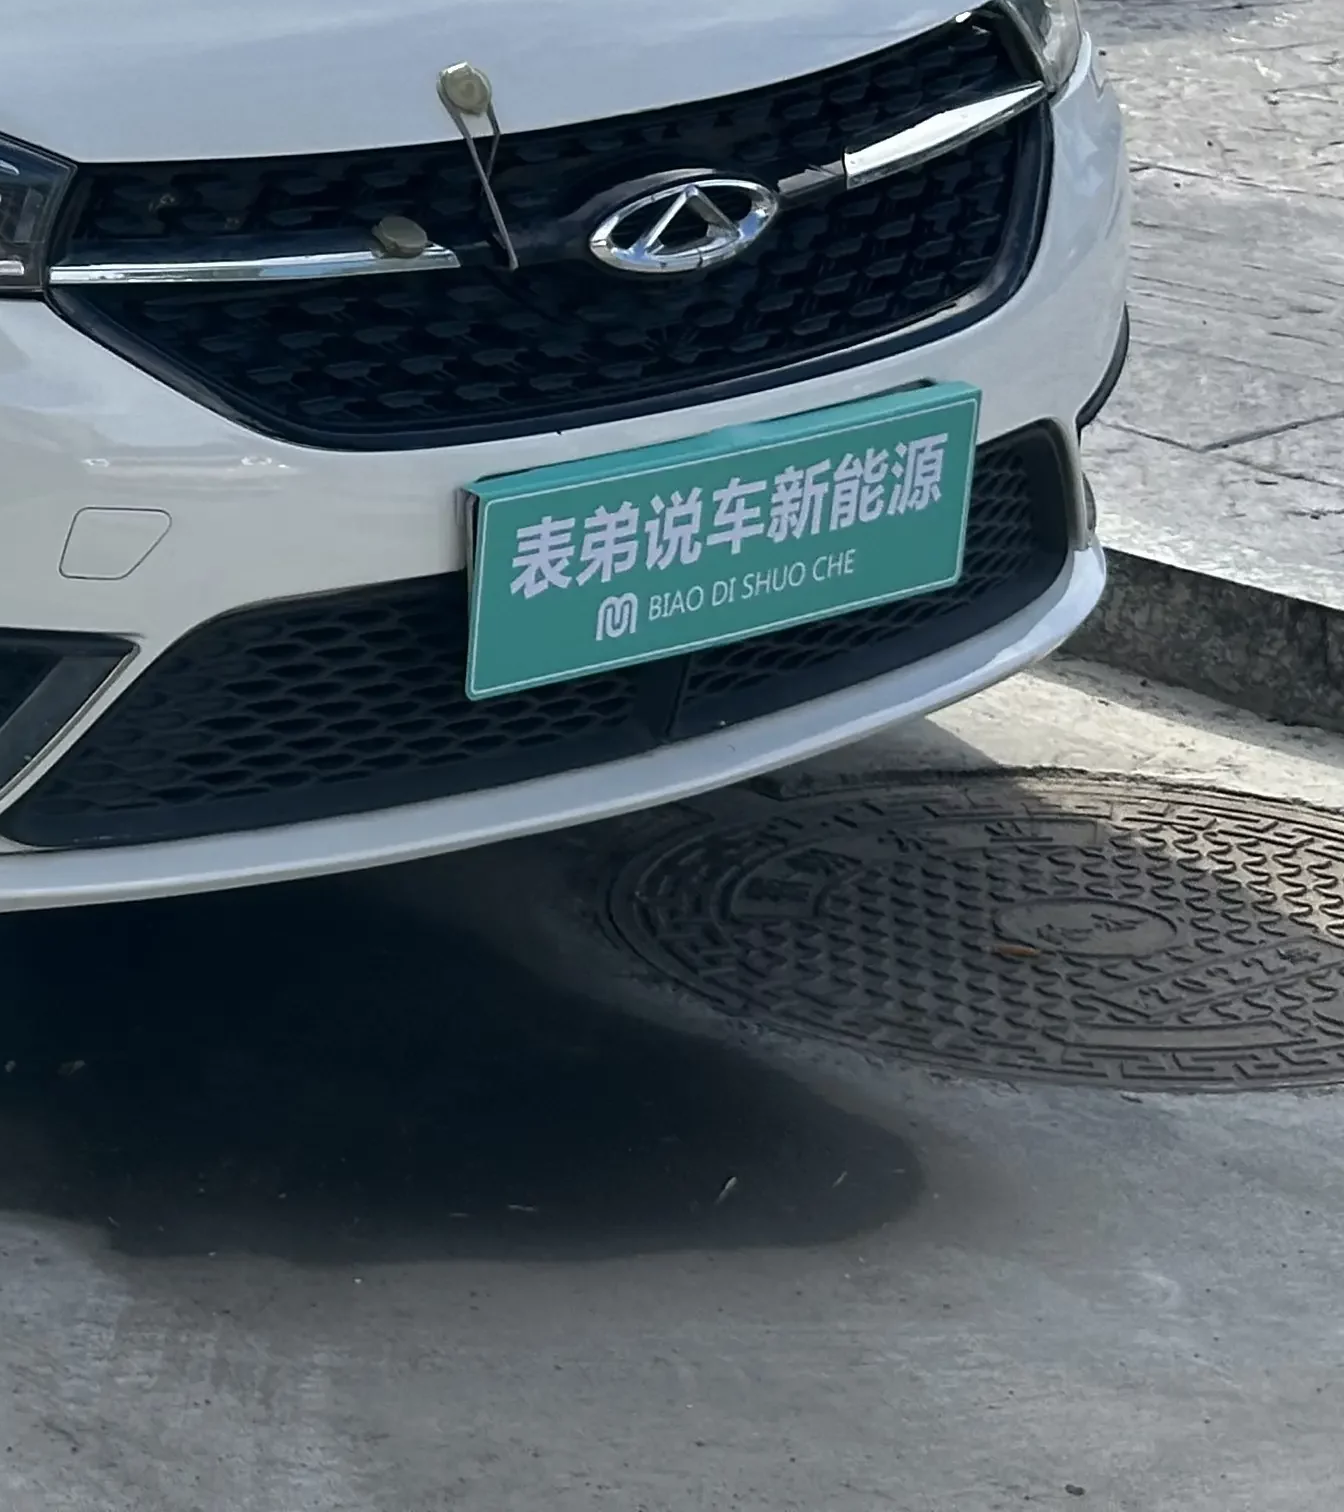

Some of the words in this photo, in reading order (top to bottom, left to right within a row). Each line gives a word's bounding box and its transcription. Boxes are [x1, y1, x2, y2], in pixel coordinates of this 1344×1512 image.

[510, 432, 949, 599] 表弟说车新能源
[648, 586, 703, 621] BIAO
[711, 577, 735, 607] DI
[742, 563, 806, 600] SHUO
[814, 548, 856, 583] CHE
